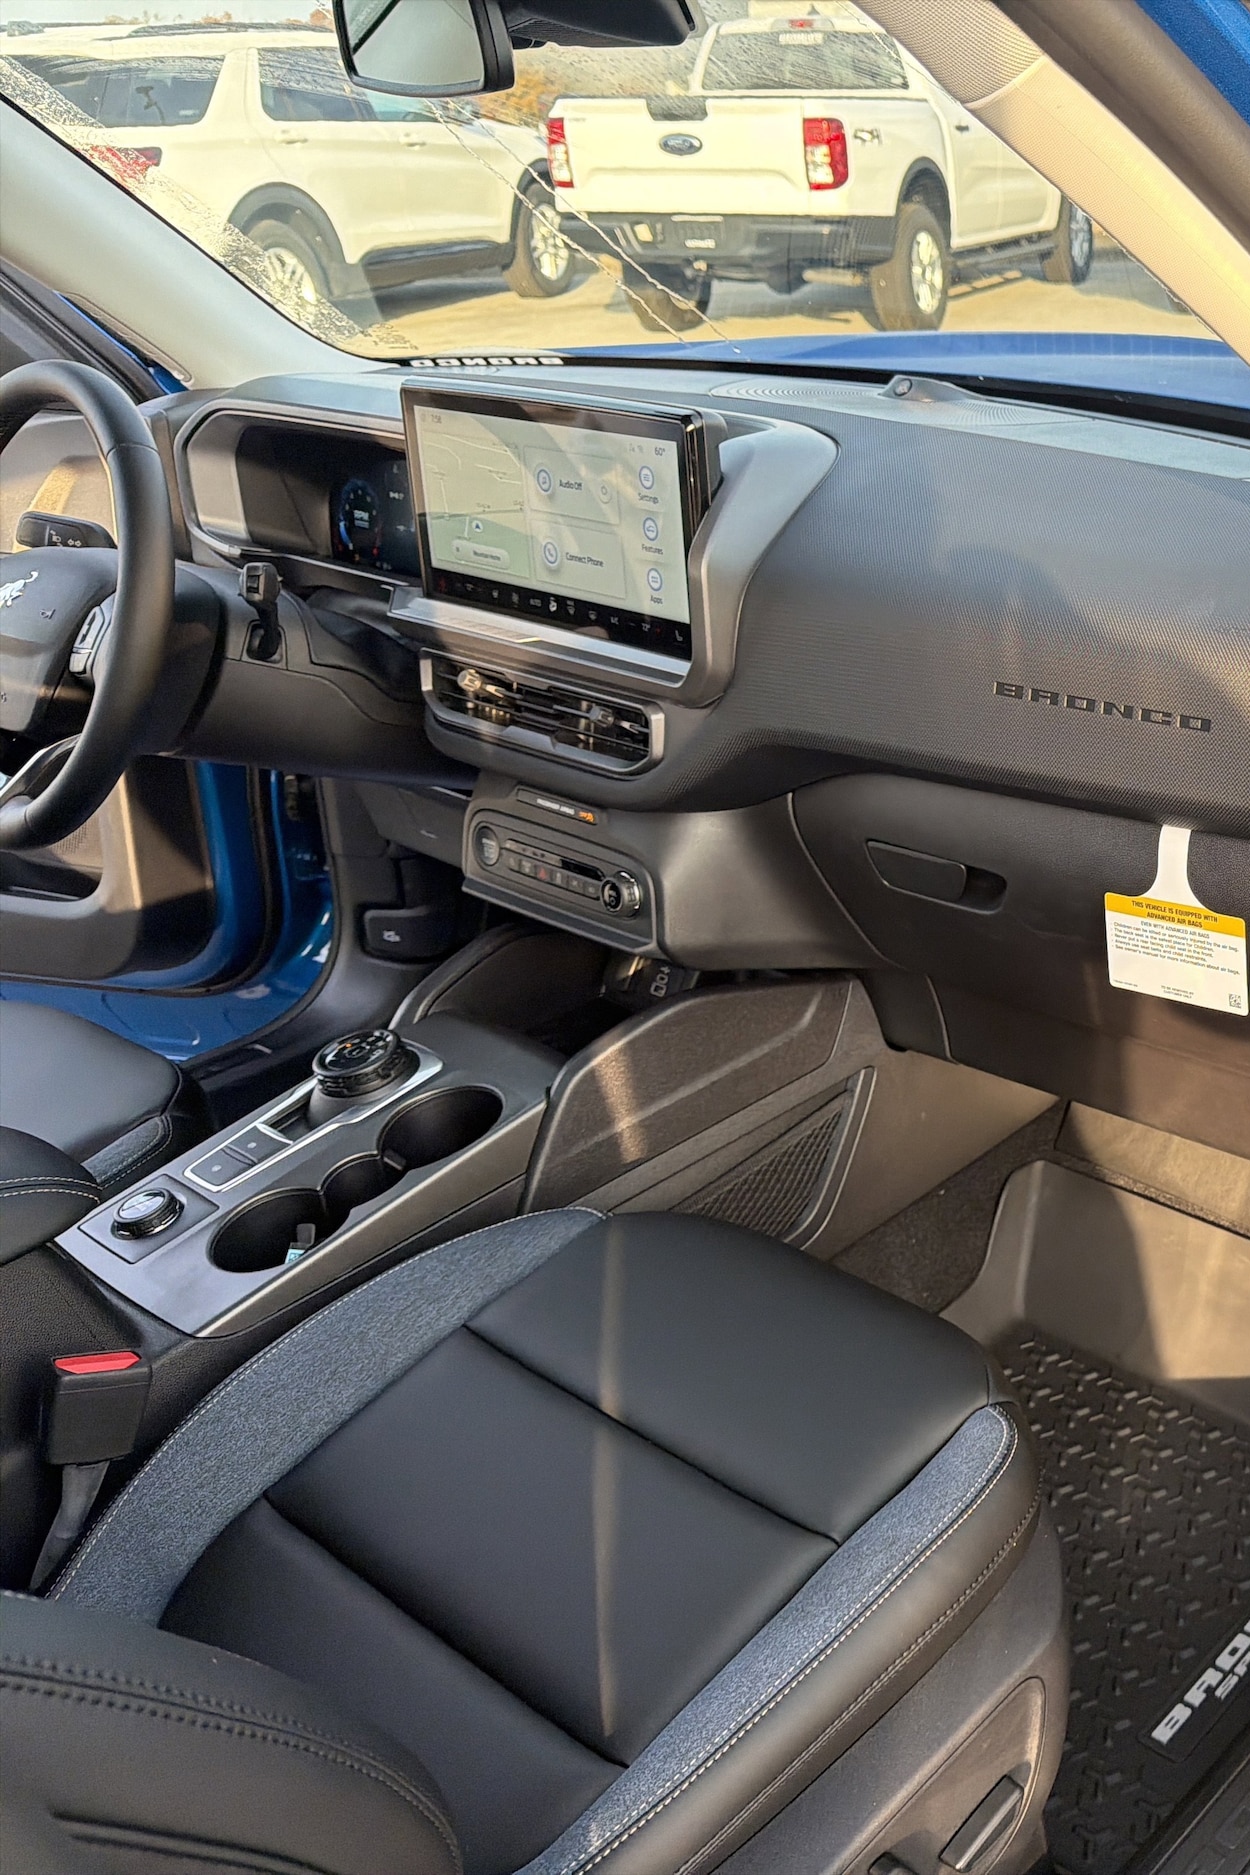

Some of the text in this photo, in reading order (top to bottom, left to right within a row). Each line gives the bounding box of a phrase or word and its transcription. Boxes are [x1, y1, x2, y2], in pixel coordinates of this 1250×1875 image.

[558, 479, 583, 491] Audio Off
[638, 492, 660, 505] Settings
[641, 543, 664, 556] Features
[565, 552, 605, 568] Connect Phone
[650, 594, 664, 605] Apps
[993, 680, 1212, 733] BRONCO
[1132, 900, 1143, 908] THIS
[1145, 903, 1166, 912] VEHICLE
[1175, 909, 1201, 919] EQUIPPED
[1203, 914, 1217, 922] WITH
[1146, 912, 1202, 928] ADVANCED AIR BAGS
[1165, 925, 1187, 934] ADVANCED
